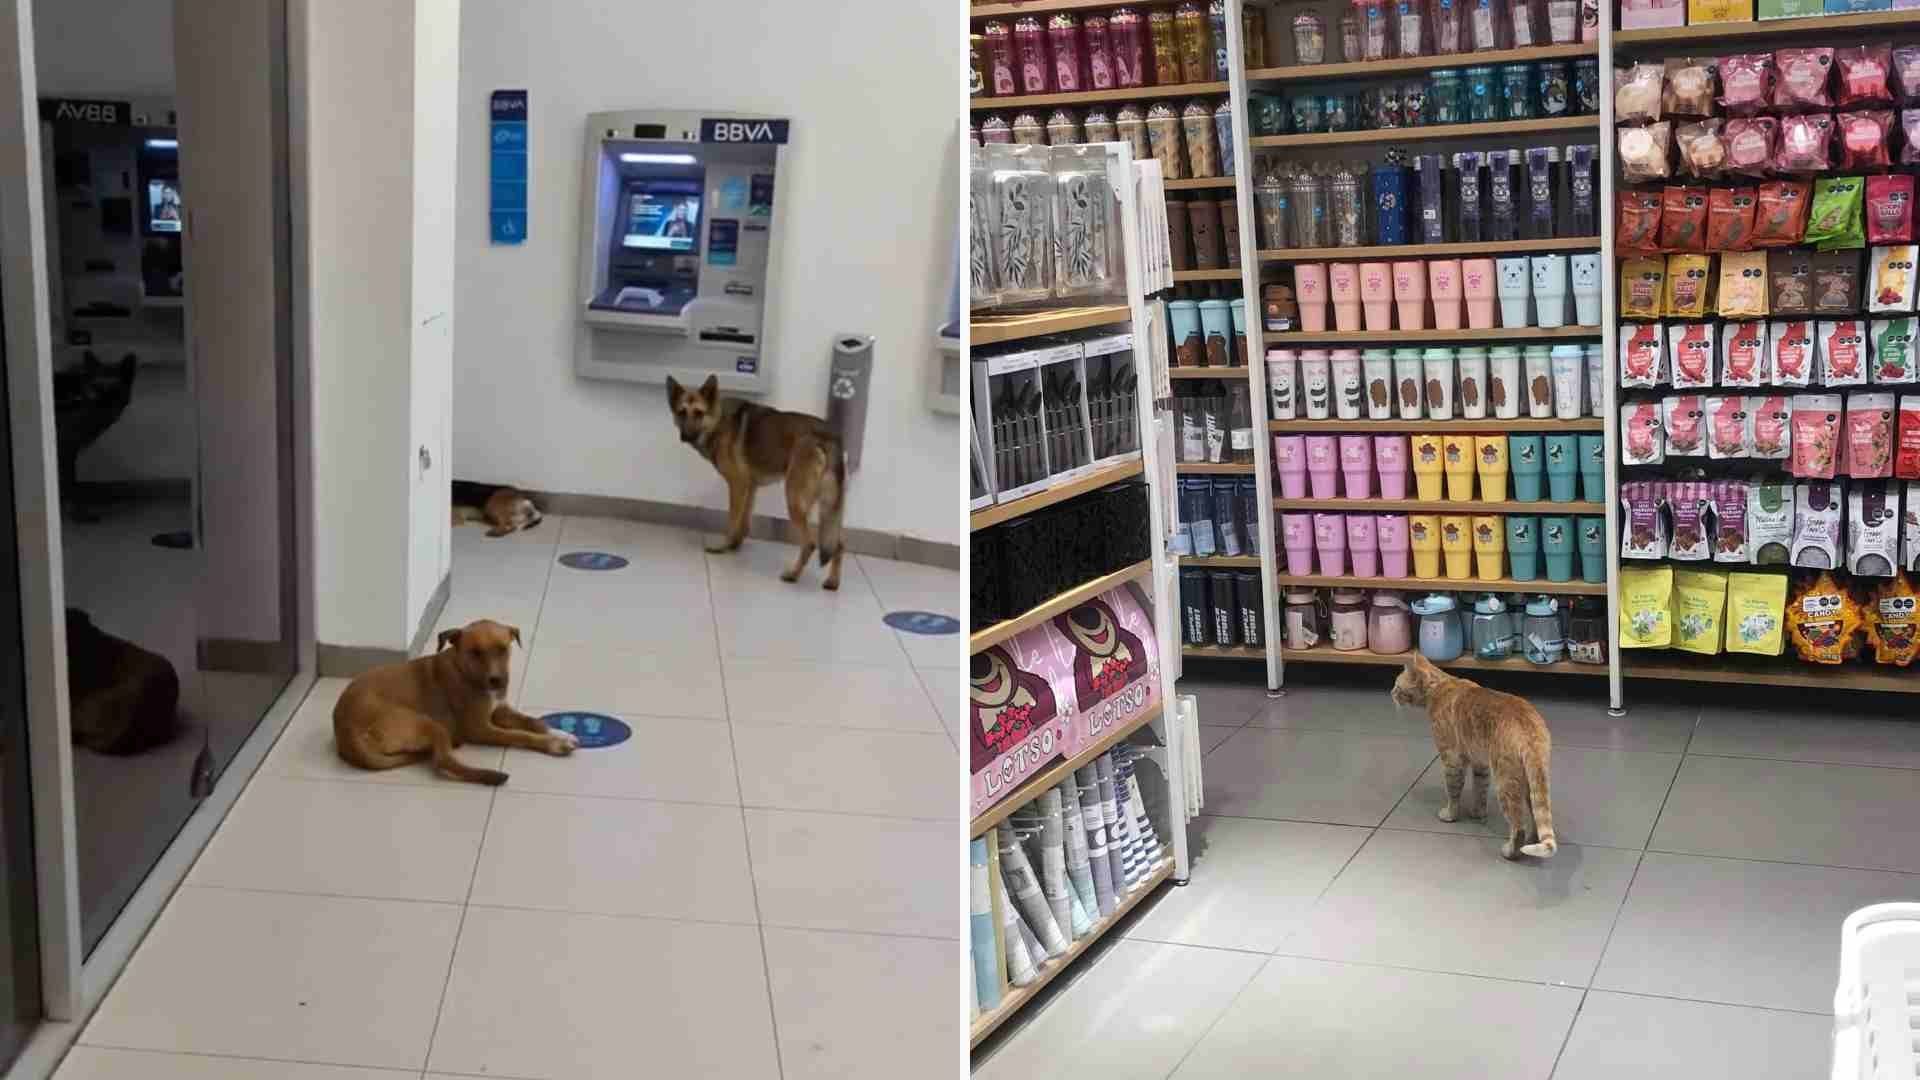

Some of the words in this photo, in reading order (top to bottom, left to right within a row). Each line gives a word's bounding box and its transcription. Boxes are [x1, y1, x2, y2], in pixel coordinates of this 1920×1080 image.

[714, 122, 774, 142] BBVA
[1089, 684, 1144, 737] LOTSO
[983, 727, 1055, 798] LOTSO
